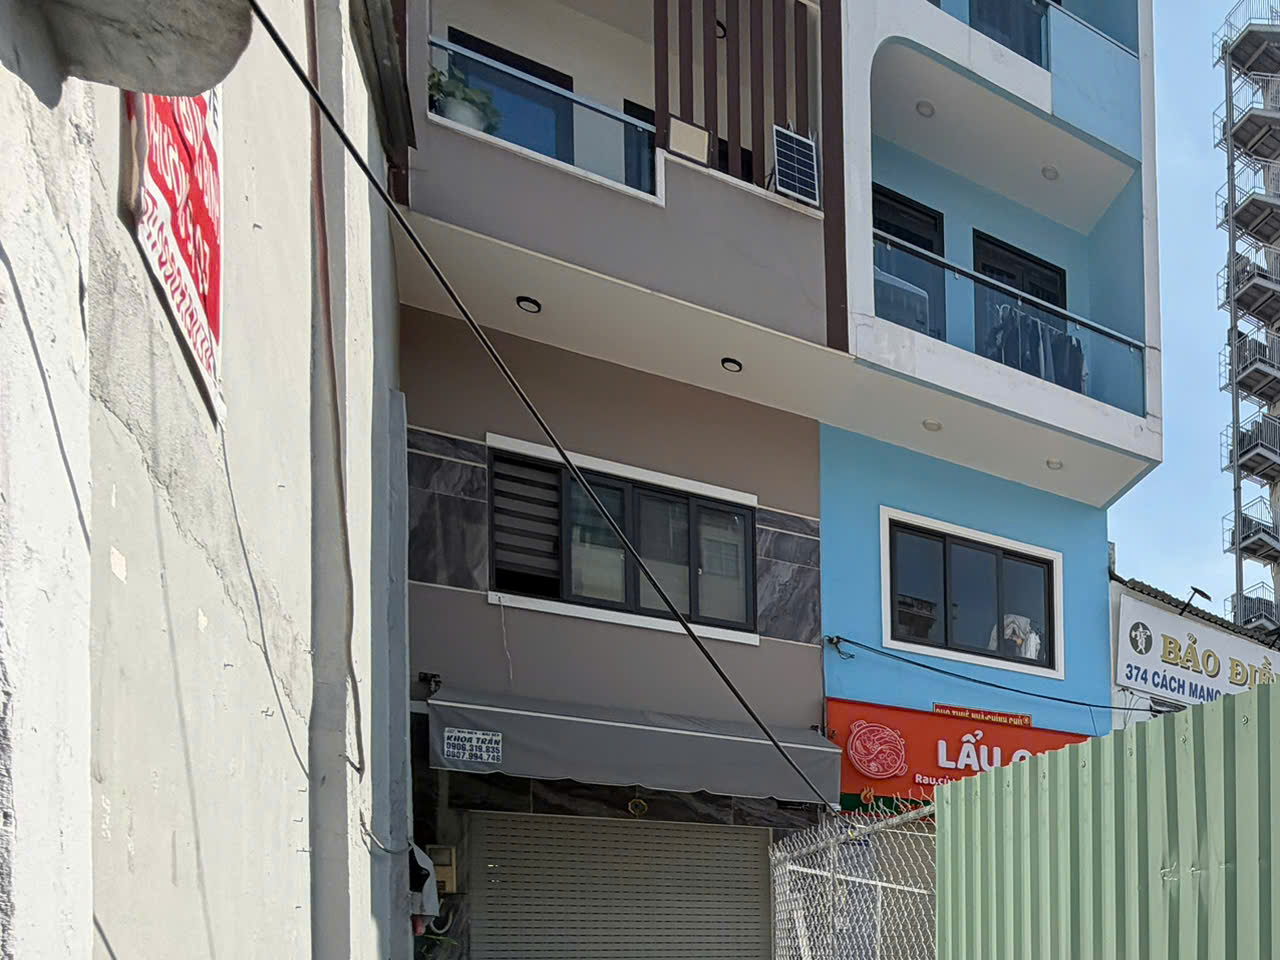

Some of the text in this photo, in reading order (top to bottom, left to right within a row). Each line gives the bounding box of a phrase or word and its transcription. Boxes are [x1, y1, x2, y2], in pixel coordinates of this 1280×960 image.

[1160, 632, 1221, 679] BẢO
[1125, 663, 1149, 685] 374
[1151, 669, 1186, 696] CÁCH
[937, 729, 1001, 772] LẨU
